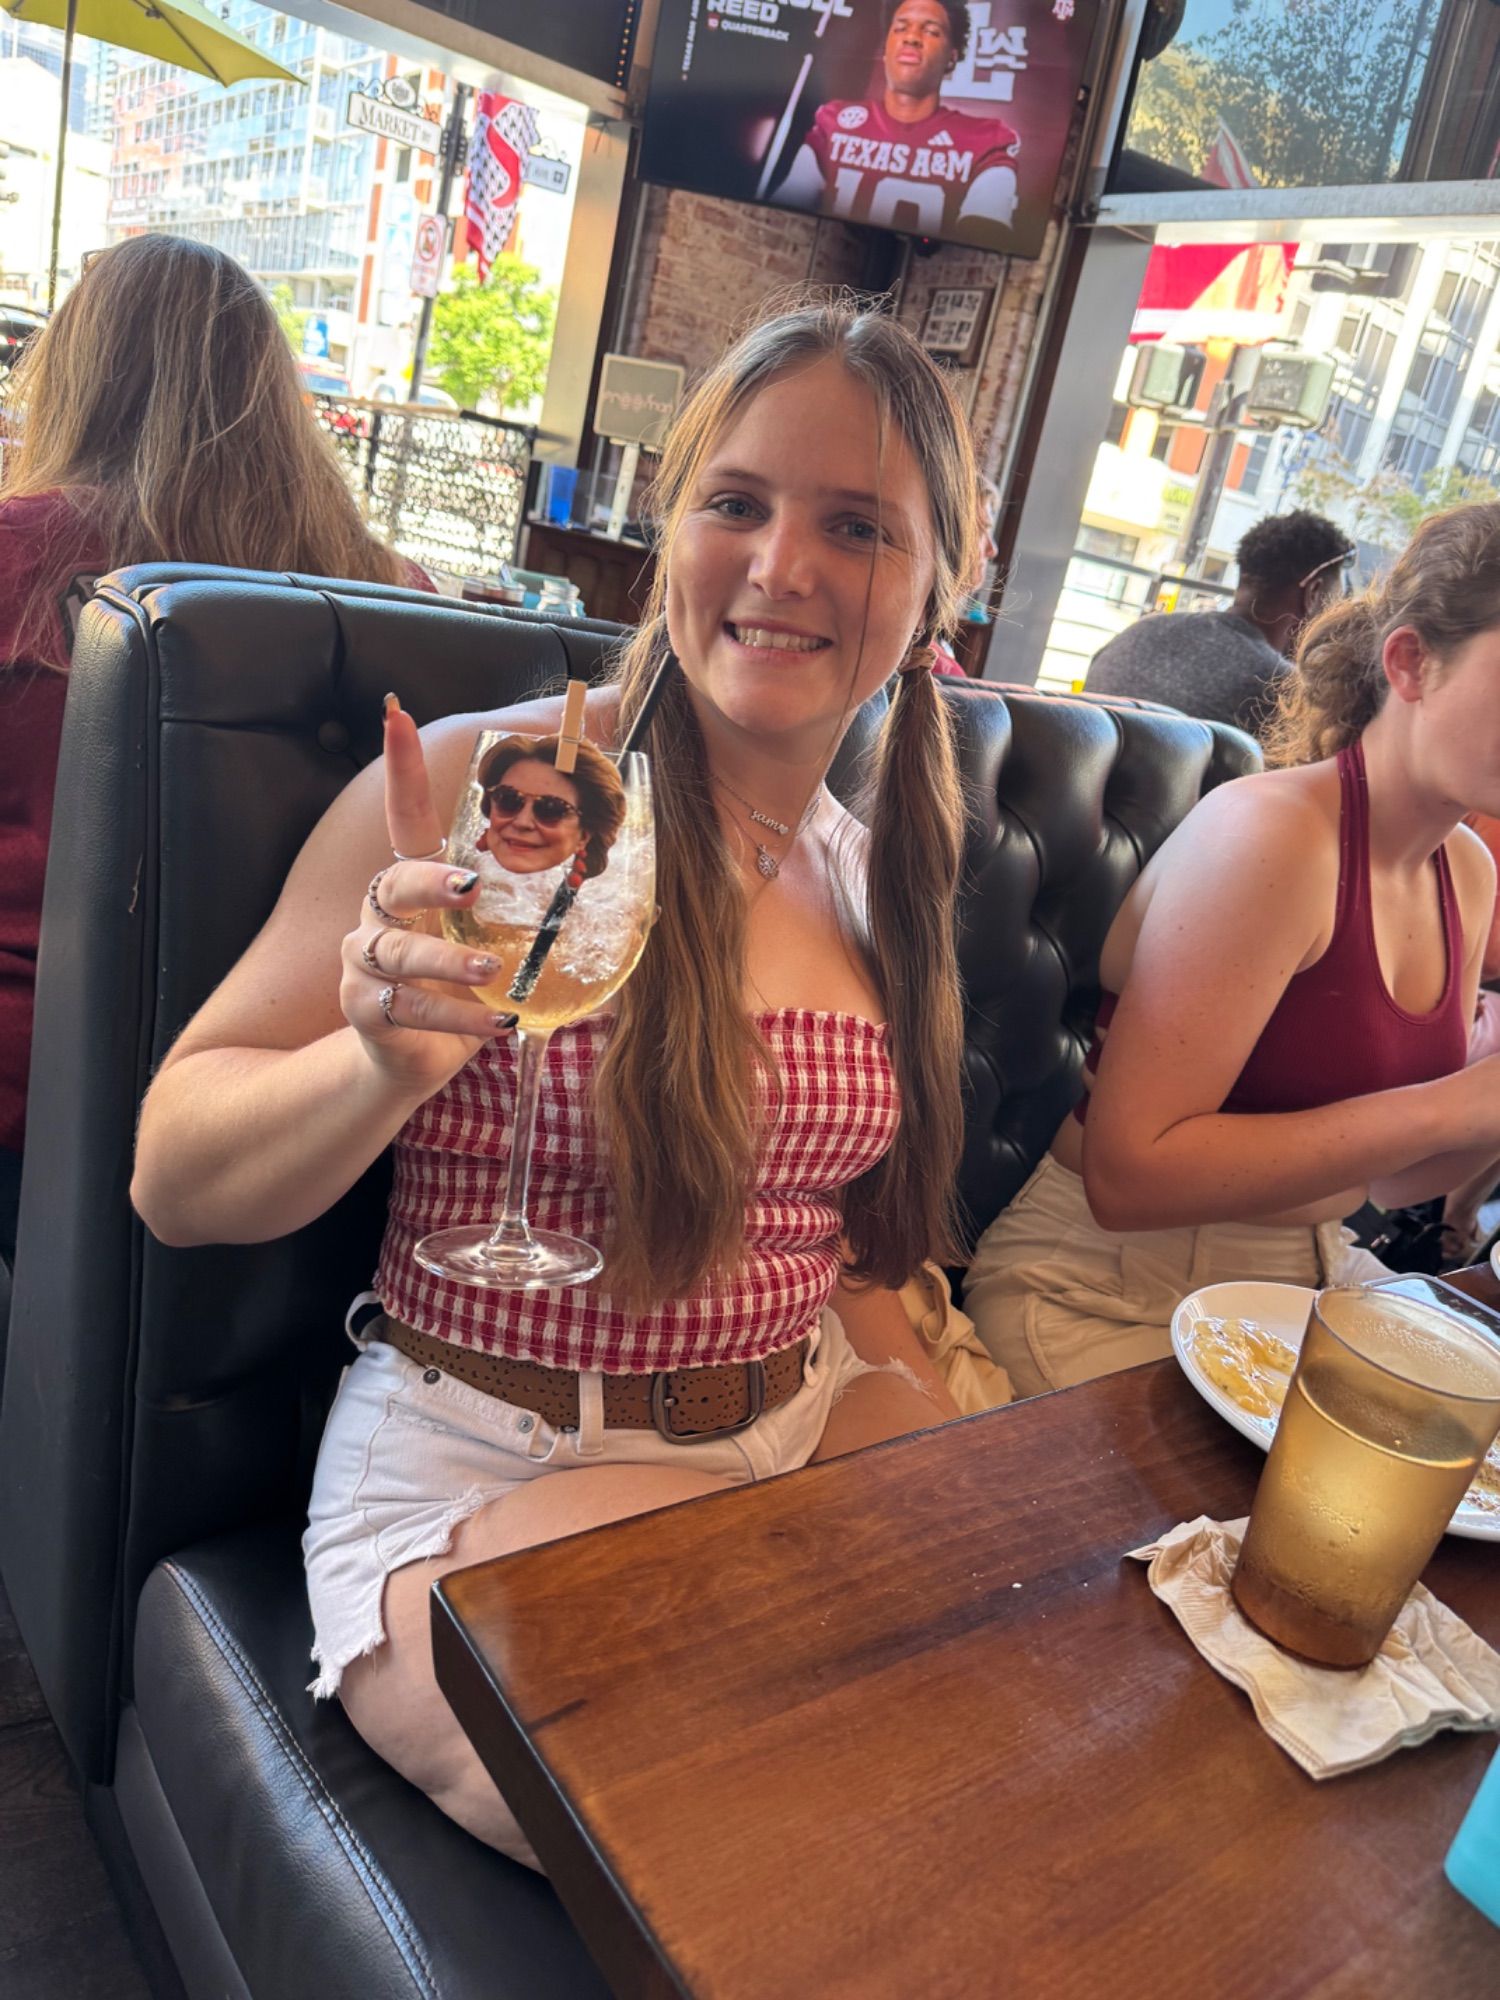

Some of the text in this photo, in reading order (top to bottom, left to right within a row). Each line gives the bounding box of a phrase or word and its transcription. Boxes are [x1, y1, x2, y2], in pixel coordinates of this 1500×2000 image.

[721, 19, 790, 42] QUARTERBACK
[360, 101, 421, 141] MARKET
[830, 132, 973, 183] TEXAS A&M
